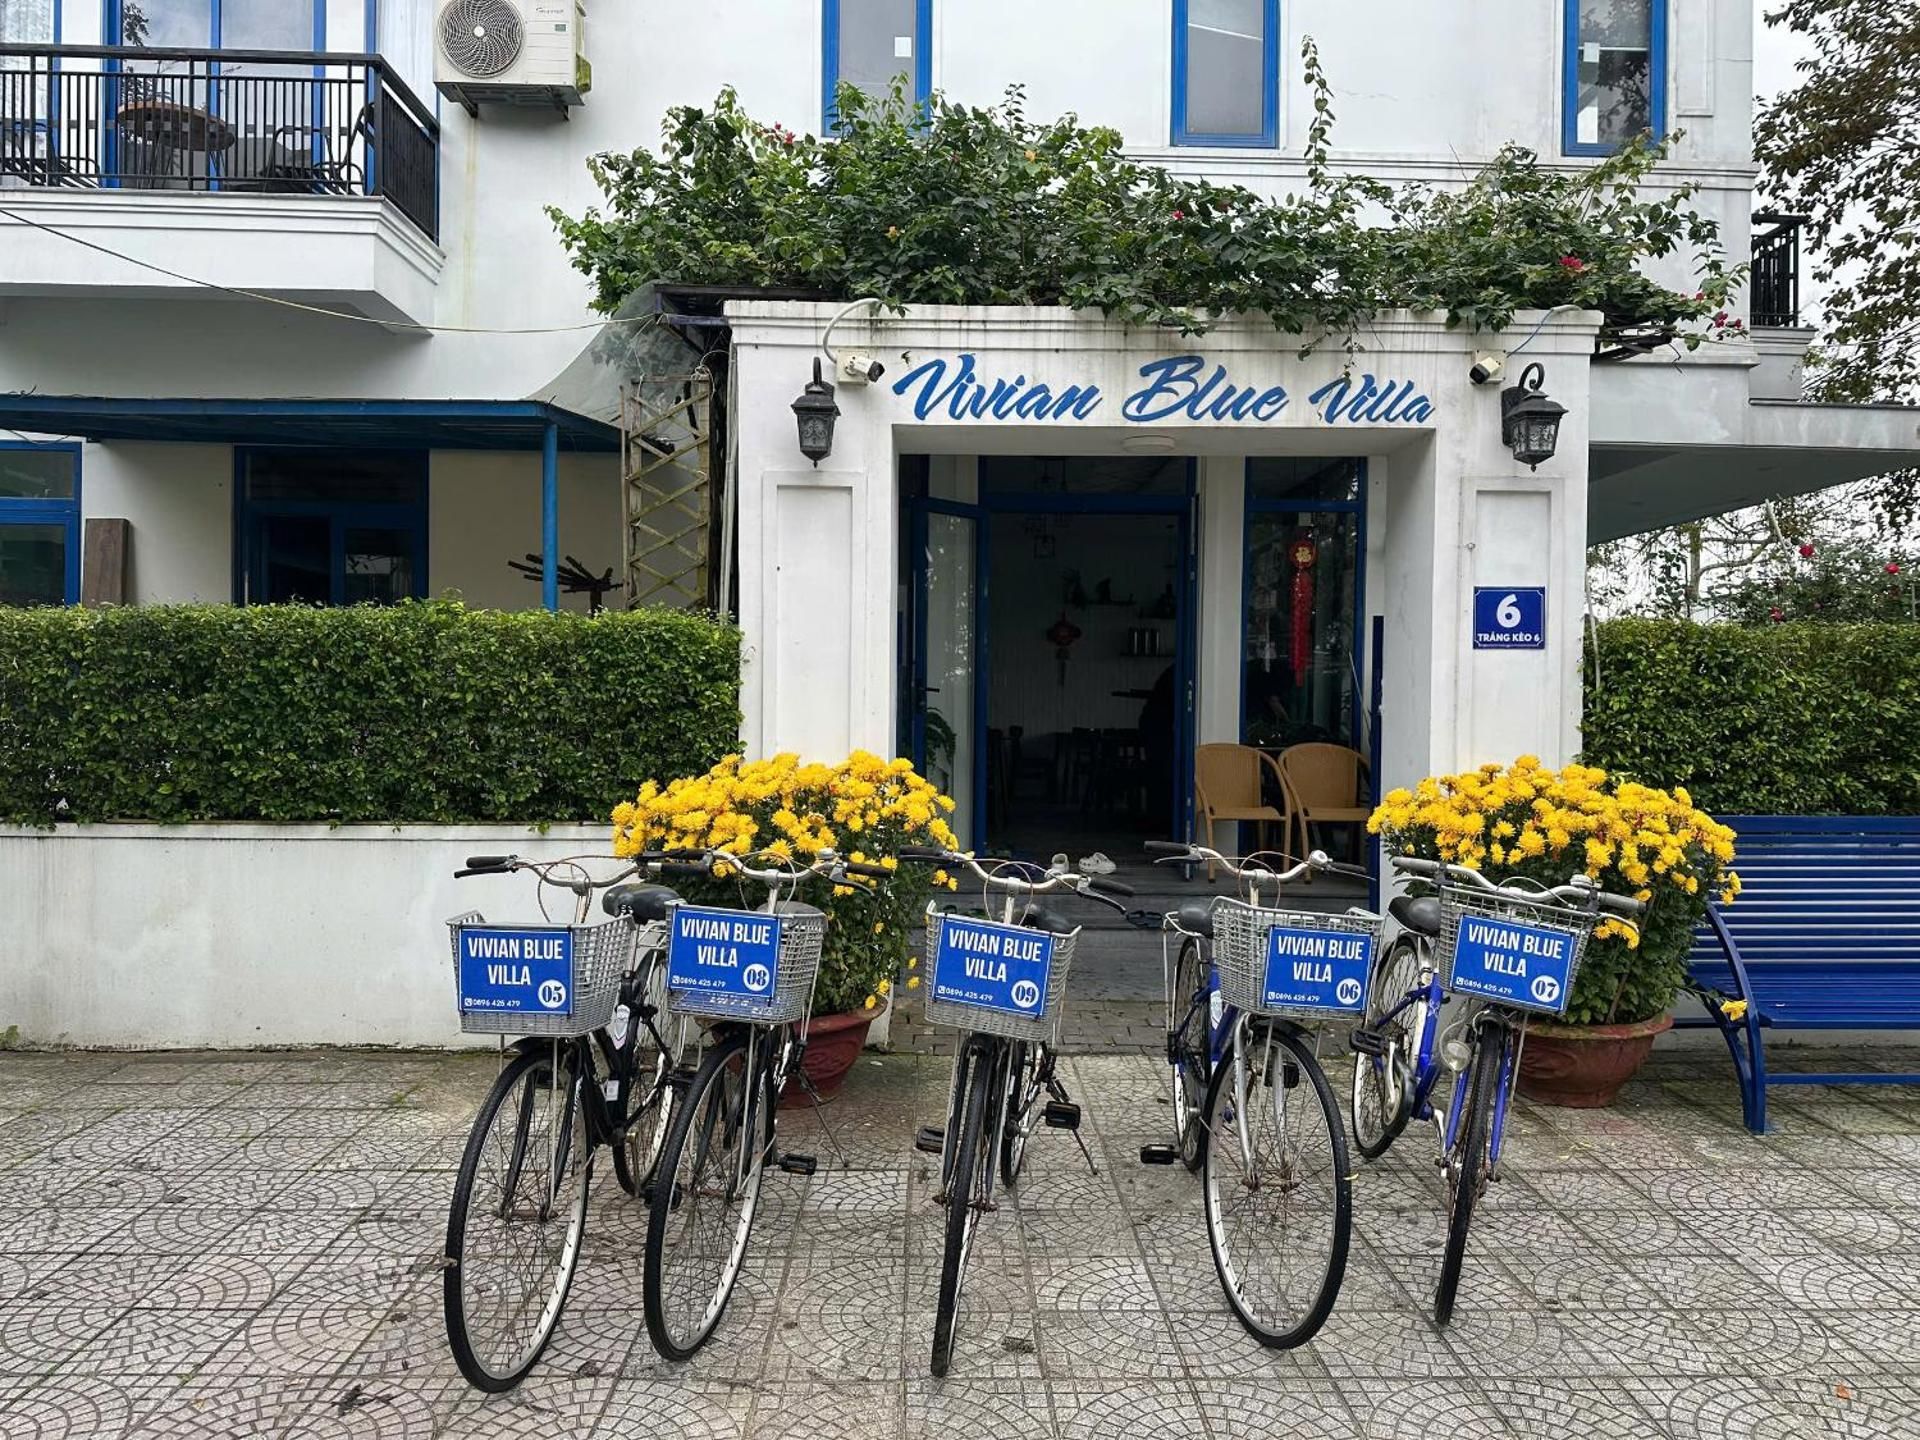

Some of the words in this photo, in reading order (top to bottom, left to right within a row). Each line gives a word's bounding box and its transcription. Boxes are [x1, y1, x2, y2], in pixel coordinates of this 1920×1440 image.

[892, 353, 1103, 421] Vivian
[1122, 355, 1289, 422] Blue
[1308, 374, 1436, 424] Villa
[1496, 593, 1521, 628] 6
[1534, 633, 1540, 642] 6
[681, 917, 730, 941] VIVIAN
[733, 922, 772, 945] BLUE
[1468, 923, 1520, 951] VIVIAN
[1522, 934, 1564, 960] BLUE
[467, 937, 520, 958] VIVIAN
[524, 938, 564, 960] BLUE
[697, 944, 738, 968] VILLA
[949, 928, 1000, 956] VIVIAN
[1003, 937, 1043, 962] BLUE
[1278, 935, 1326, 958] VIVIAN
[1328, 939, 1364, 960] BLUE
[487, 964, 532, 986] VILLA
[965, 957, 1007, 983] VILLA
[1293, 961, 1332, 983] VILLA
[1484, 951, 1527, 978] VILLA
[712, 980, 726, 988] 479
[747, 968, 767, 986] 08
[542, 985, 563, 1003] 05
[979, 993, 993, 1001] 479
[1015, 985, 1036, 1003] 09
[1340, 982, 1359, 1000] 06
[1498, 986, 1512, 994] 479
[1536, 980, 1557, 998] 07
